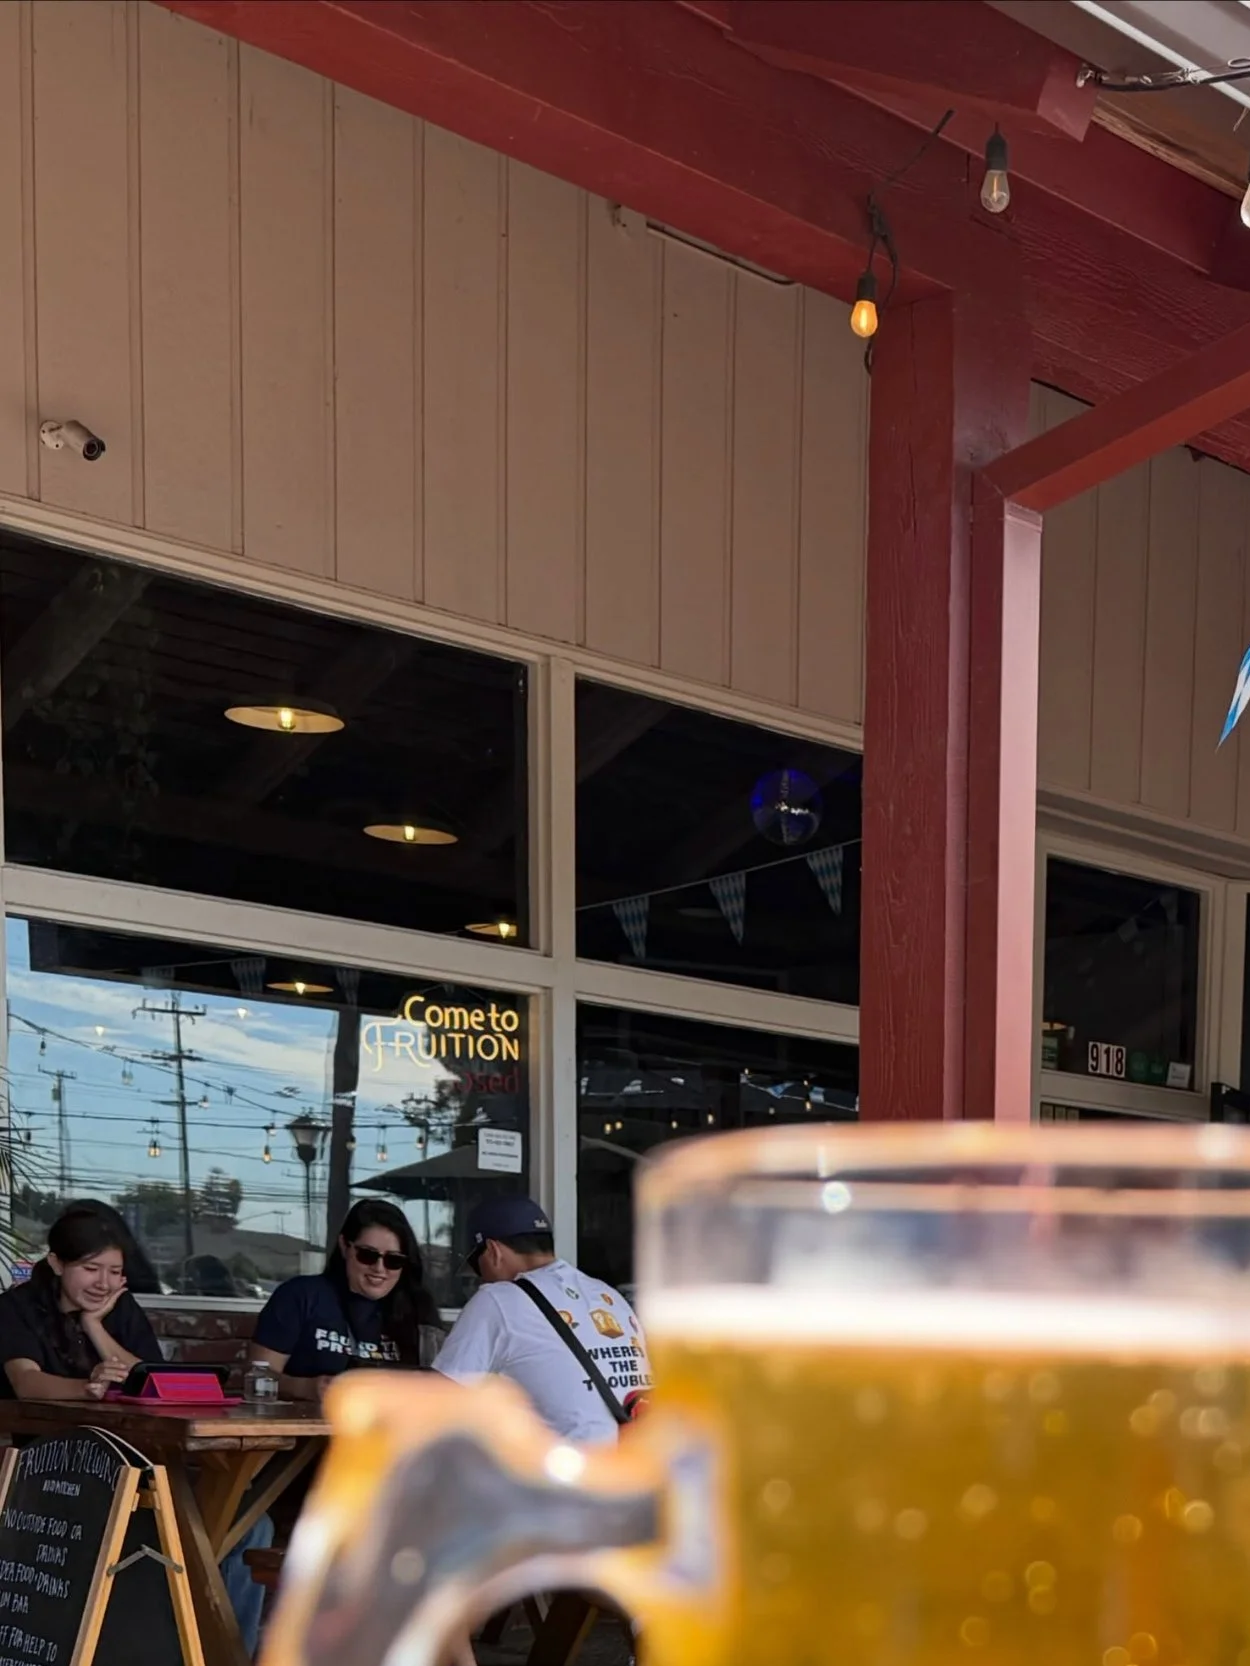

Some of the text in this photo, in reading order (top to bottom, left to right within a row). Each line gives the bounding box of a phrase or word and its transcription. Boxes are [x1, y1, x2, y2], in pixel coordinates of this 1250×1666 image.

[404, 995, 519, 1032] Come to
[361, 1014, 519, 1072] FRUITION
[1089, 1042, 1125, 1077] 918
[609, 1360, 638, 1373] THE
[582, 1374, 653, 1392] TOUBLE
[15, 1440, 70, 1483] FRUITION
[47, 1517, 68, 1538] FOOD
[22, 1633, 46, 1657] HELP
[46, 1641, 58, 1662] TO
